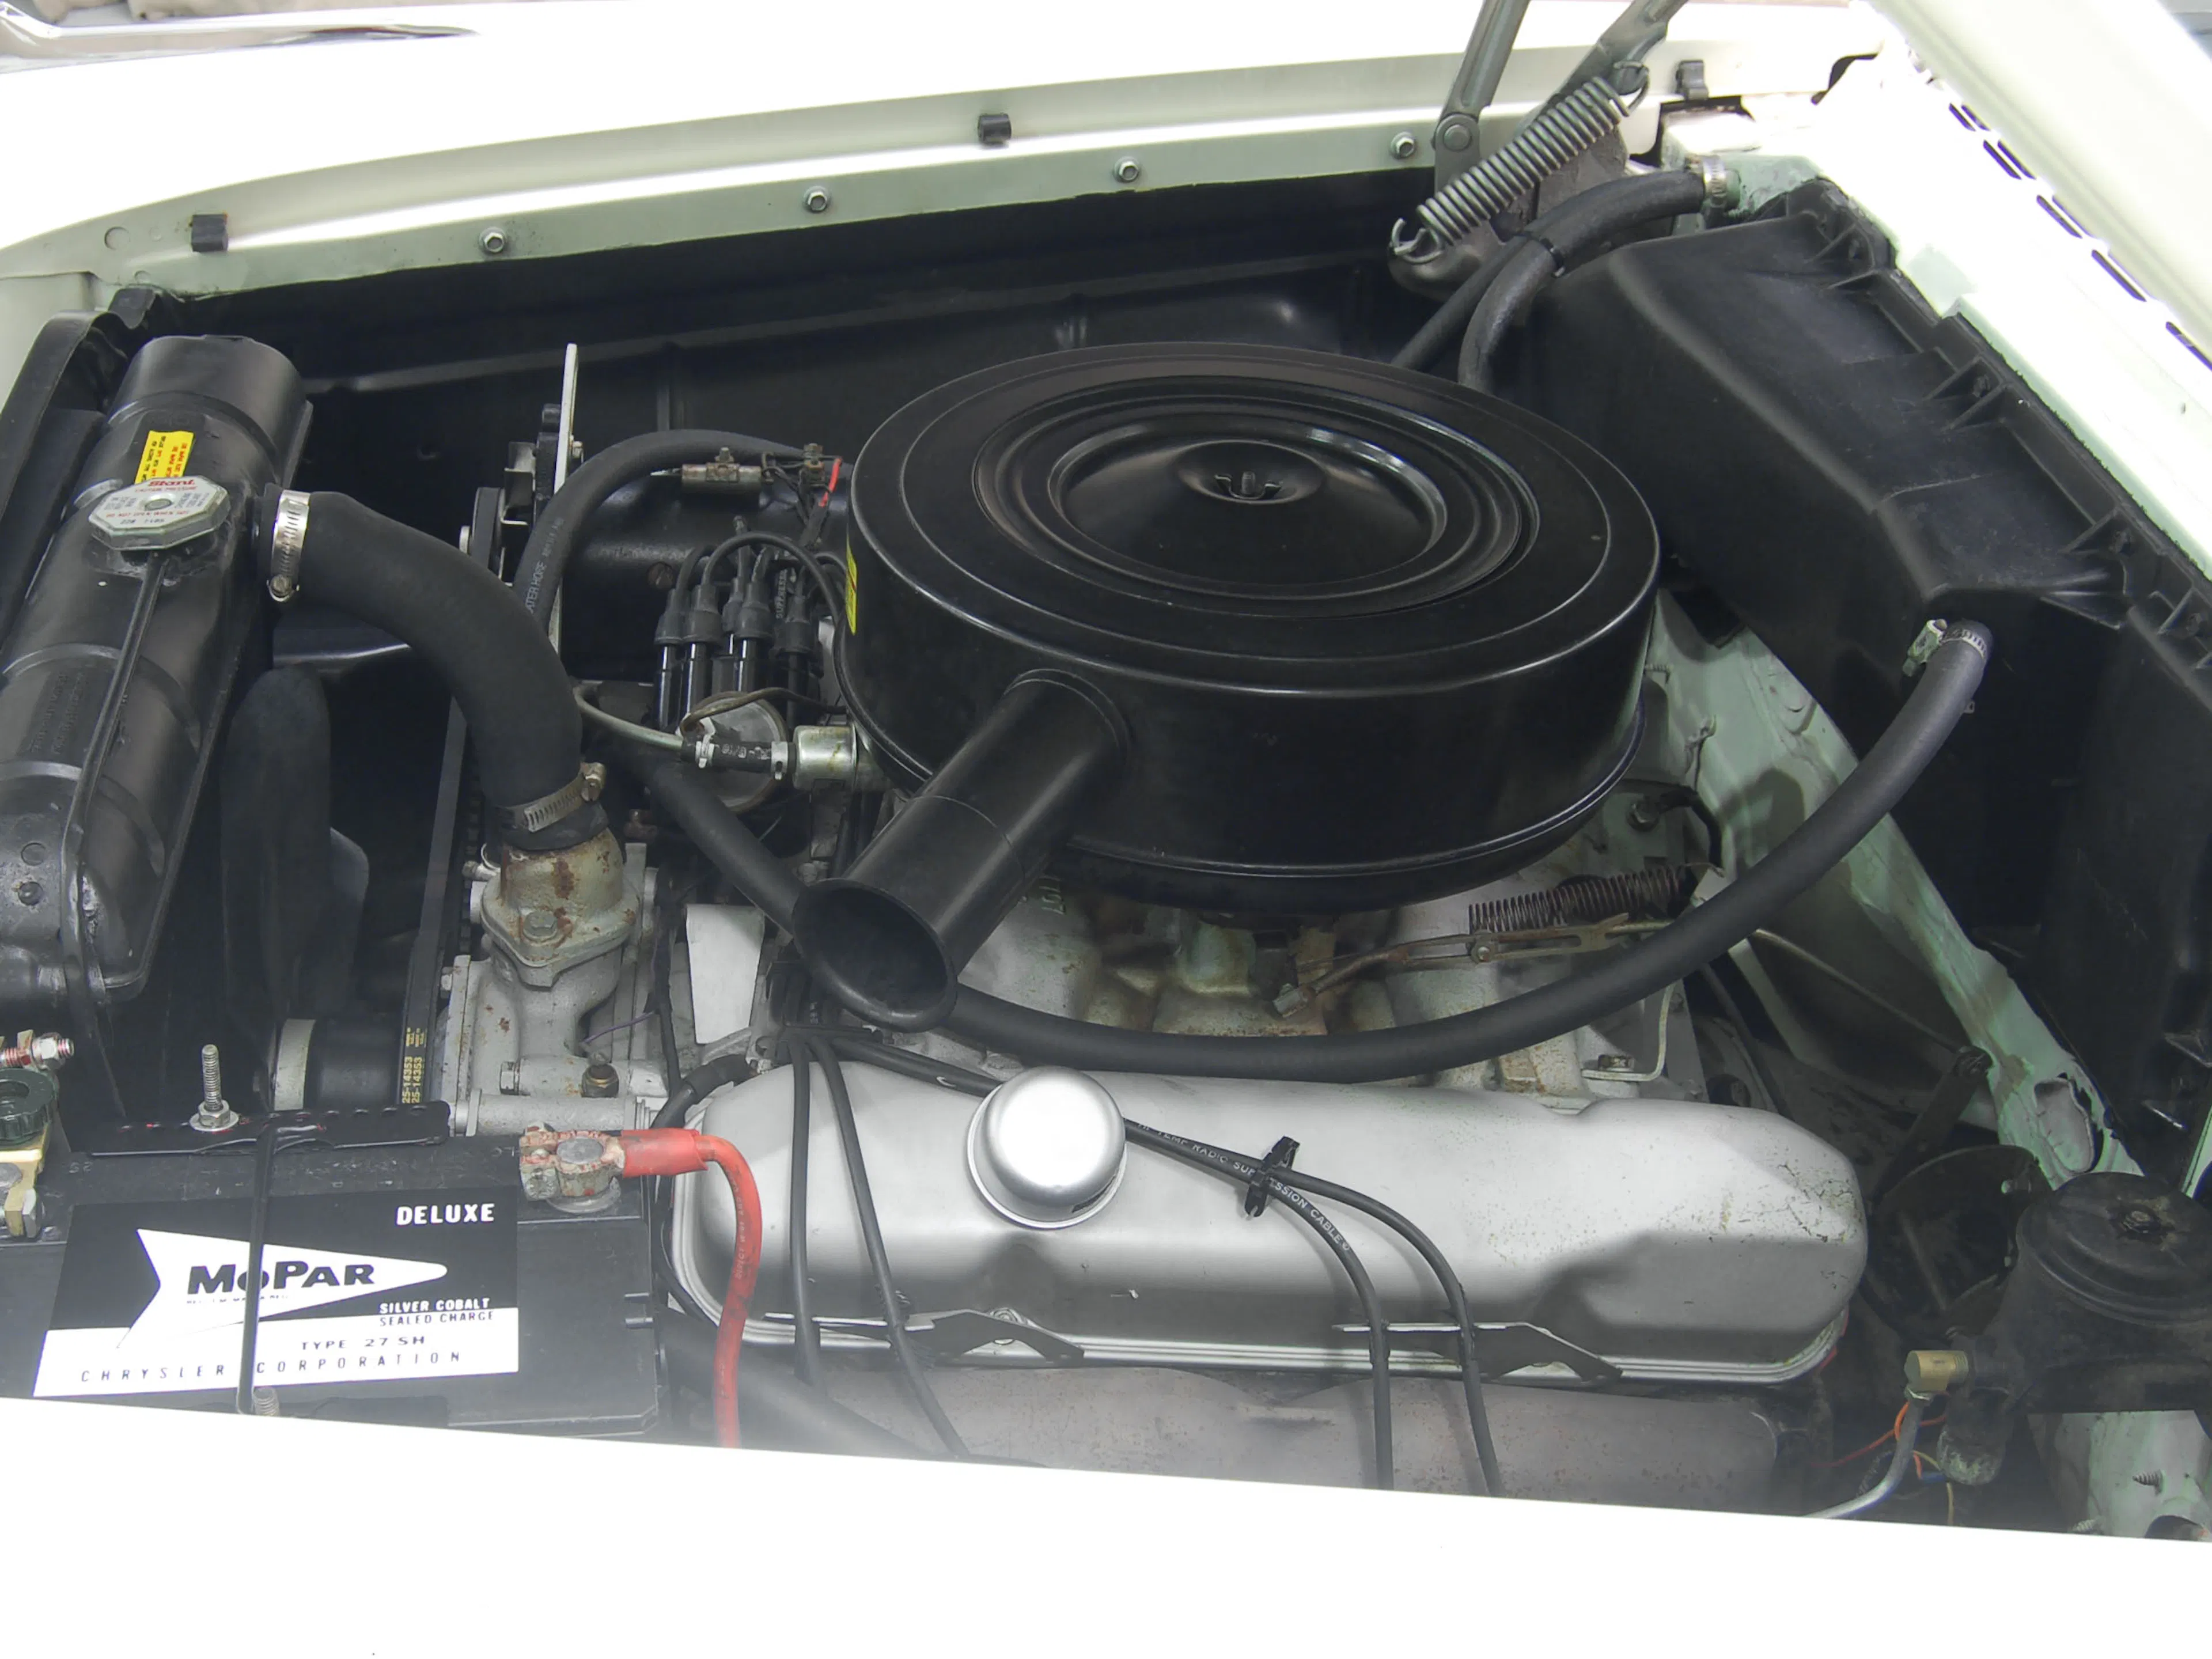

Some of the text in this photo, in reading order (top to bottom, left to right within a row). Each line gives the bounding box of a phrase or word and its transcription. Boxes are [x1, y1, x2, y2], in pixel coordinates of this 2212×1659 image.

[402, 1056, 413, 1104] 25-14353
[411, 1056, 423, 1104] 25-14353
[396, 1203, 495, 1226] DELUXE
[379, 1297, 490, 1314] SILVER COBALT
[380, 1310, 494, 1327] SEALED CHARGE
[301, 1339, 347, 1351] TYPE
[81, 1351, 461, 1382] CHRYSLER CORPORATION
